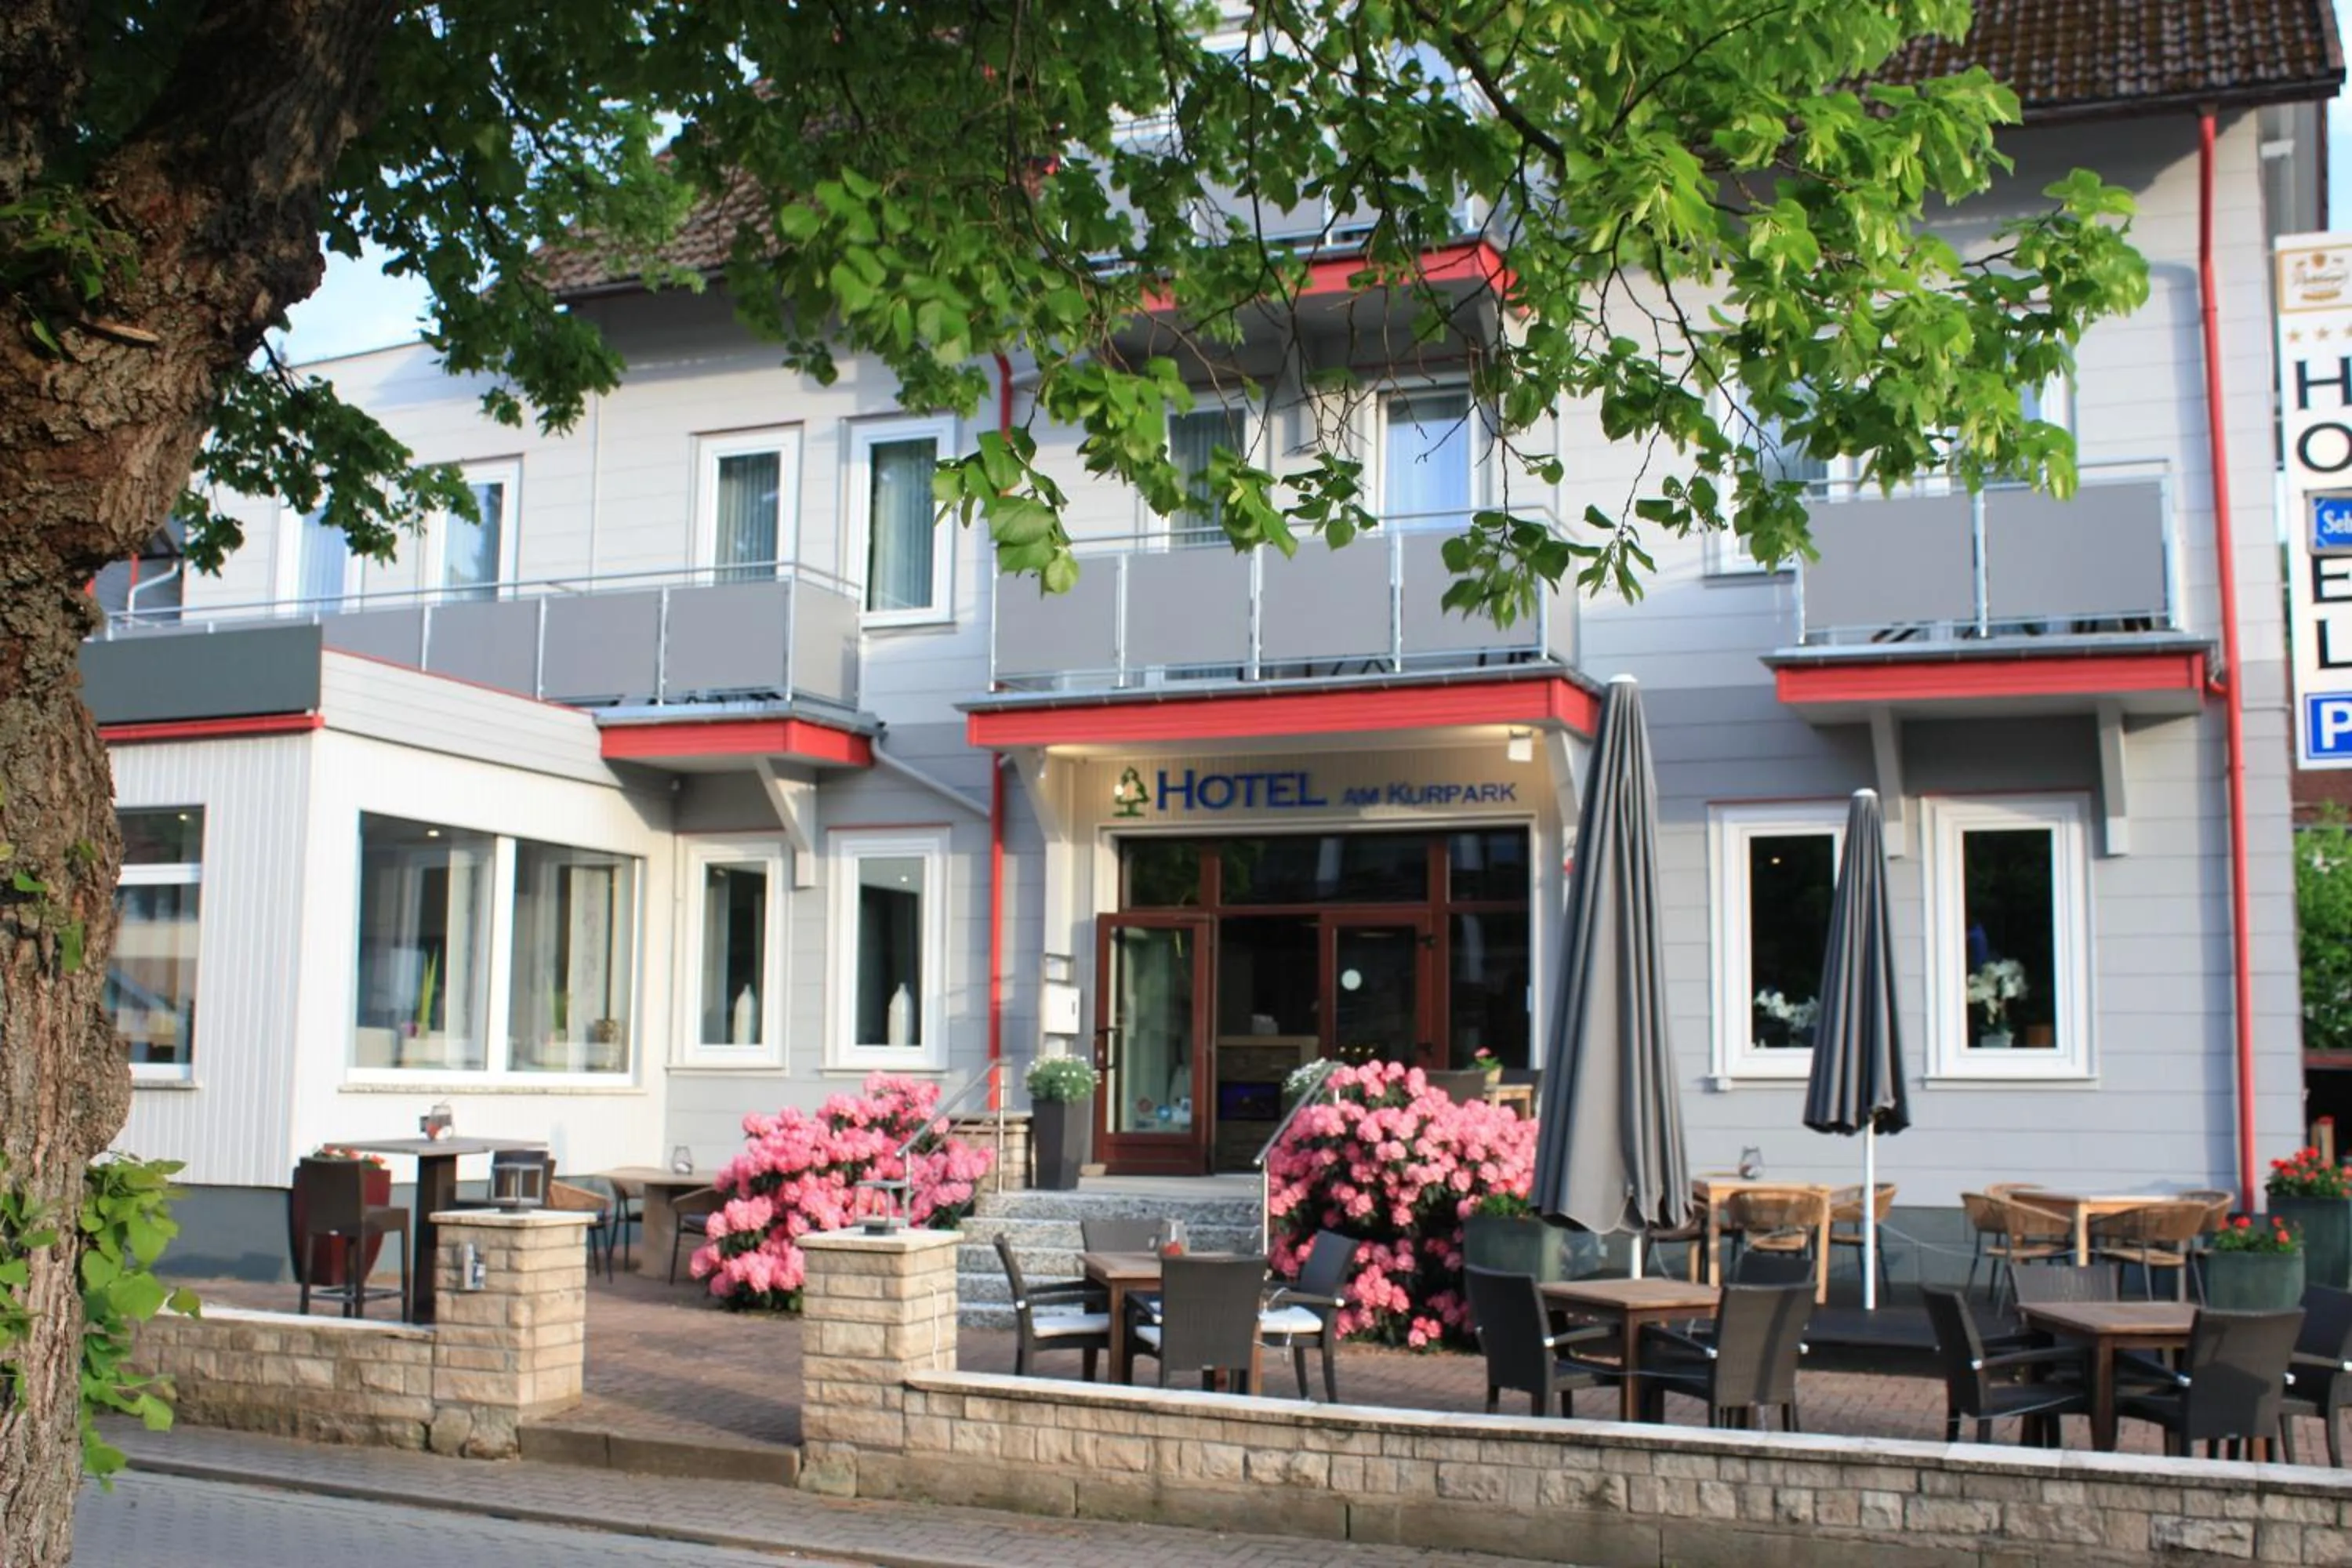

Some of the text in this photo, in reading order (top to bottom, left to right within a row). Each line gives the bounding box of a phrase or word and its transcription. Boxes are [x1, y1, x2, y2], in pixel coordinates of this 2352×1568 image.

[2296, 356, 2352, 670] HOEL
[2321, 701, 2352, 750] P
[1156, 769, 1517, 811] HOTEL AM KURPARK
